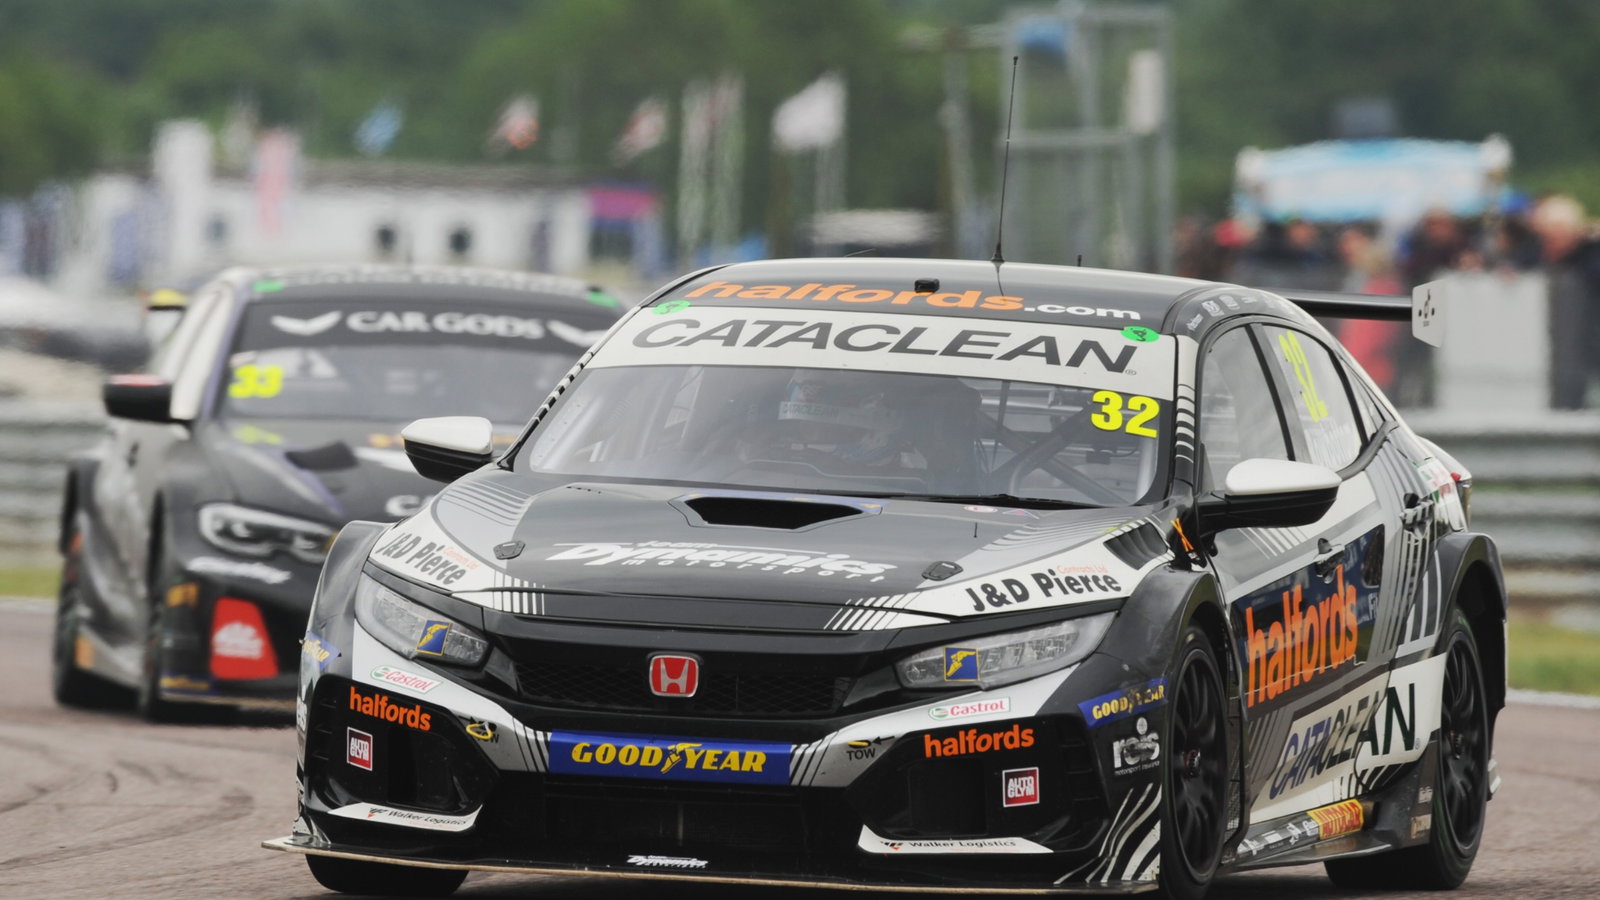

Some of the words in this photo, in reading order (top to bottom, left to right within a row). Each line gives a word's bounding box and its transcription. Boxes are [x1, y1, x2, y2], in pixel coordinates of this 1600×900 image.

[347, 312, 431, 332] CAR
[433, 313, 545, 339] GODS
[632, 319, 1138, 374] CATACLEAN
[228, 364, 283, 398] 33
[1091, 390, 1160, 438] 32
[376, 533, 421, 560] J&D
[406, 541, 467, 585] Pierce
[545, 543, 898, 575] Dynamics
[965, 578, 1030, 612] J&D
[1031, 569, 1122, 598] Pierce
[1245, 564, 1359, 708] halfords
[385, 672, 433, 691] Castrol
[350, 686, 432, 732] halfords
[950, 700, 1007, 717] Castrol
[350, 737, 370, 750] AUTO
[846, 749, 876, 761] TOW
[924, 724, 1035, 758] halfords
[1269, 683, 1416, 800] CATACLEAN
[1007, 776, 1035, 789] AUTO
[1007, 785, 1035, 798] GLYM
[959, 840, 1017, 848] Logistics
